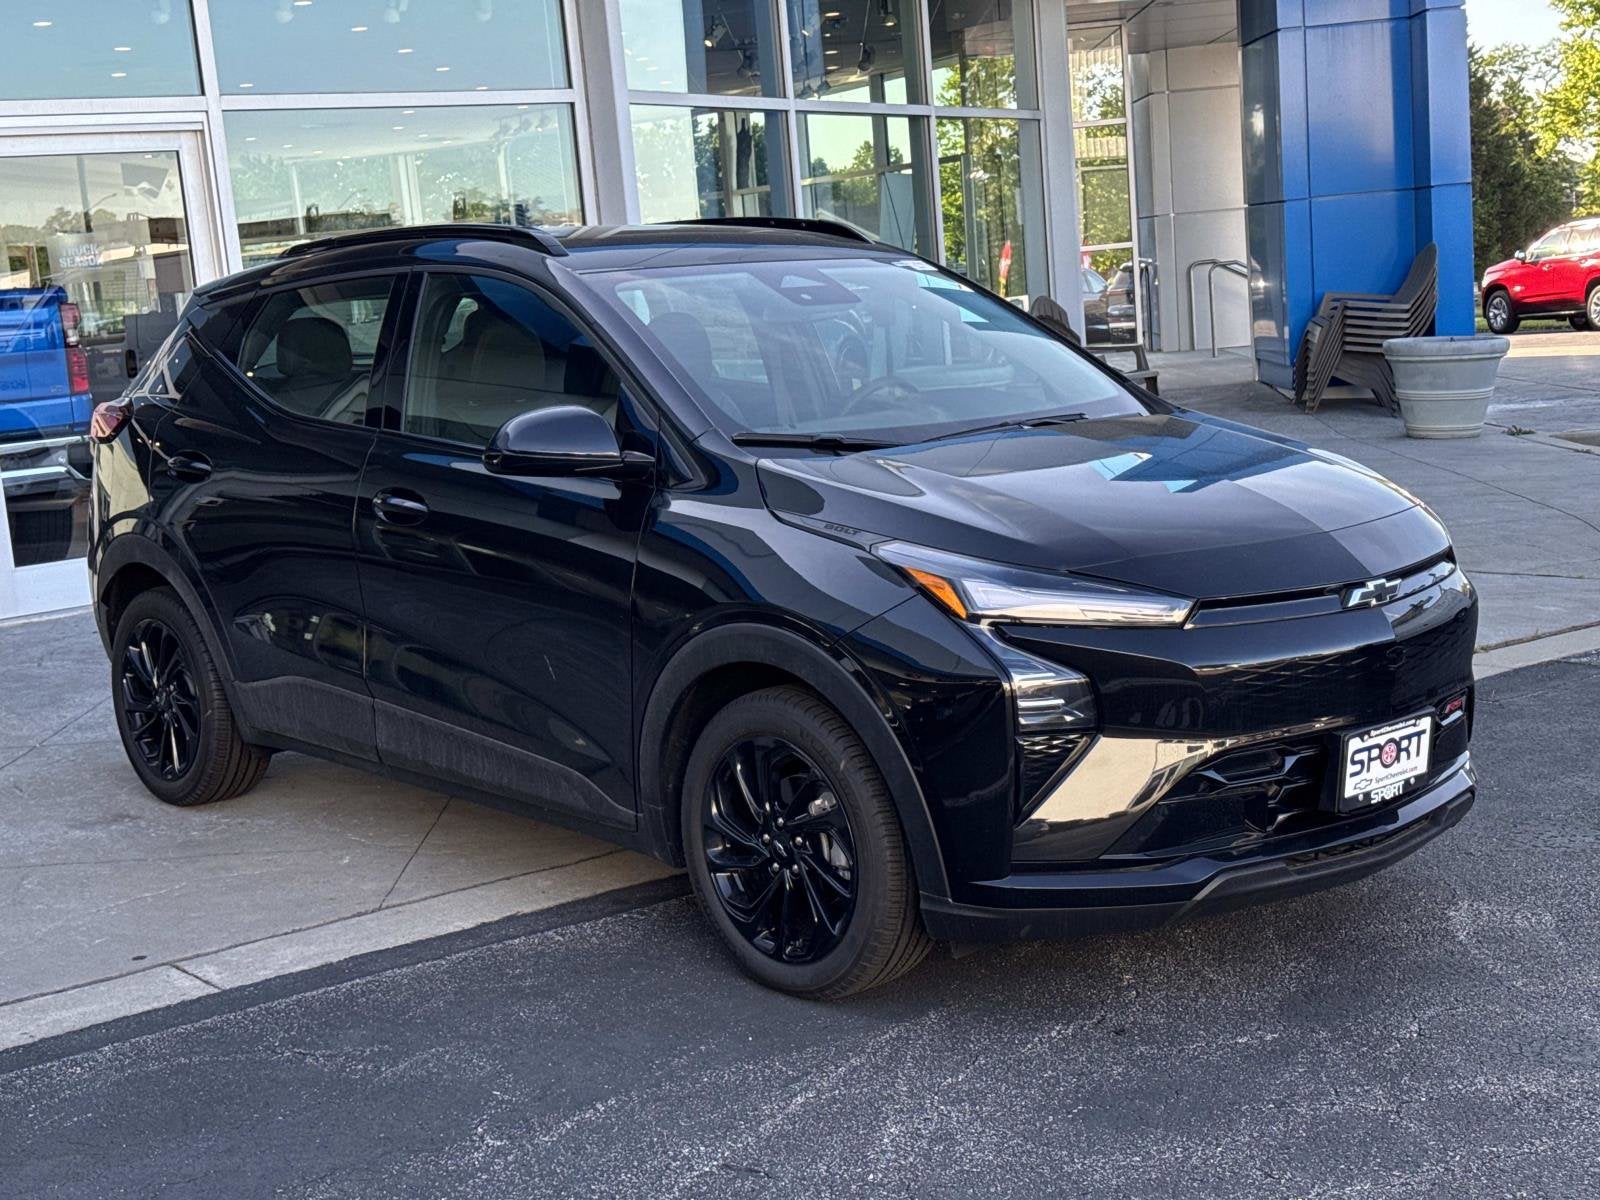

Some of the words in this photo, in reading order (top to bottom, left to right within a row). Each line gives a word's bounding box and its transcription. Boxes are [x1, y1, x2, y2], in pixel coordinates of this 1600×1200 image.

[823, 523, 860, 536] BOLT
[1349, 728, 1427, 778] SPORT
[1370, 780, 1405, 804] SPORT
